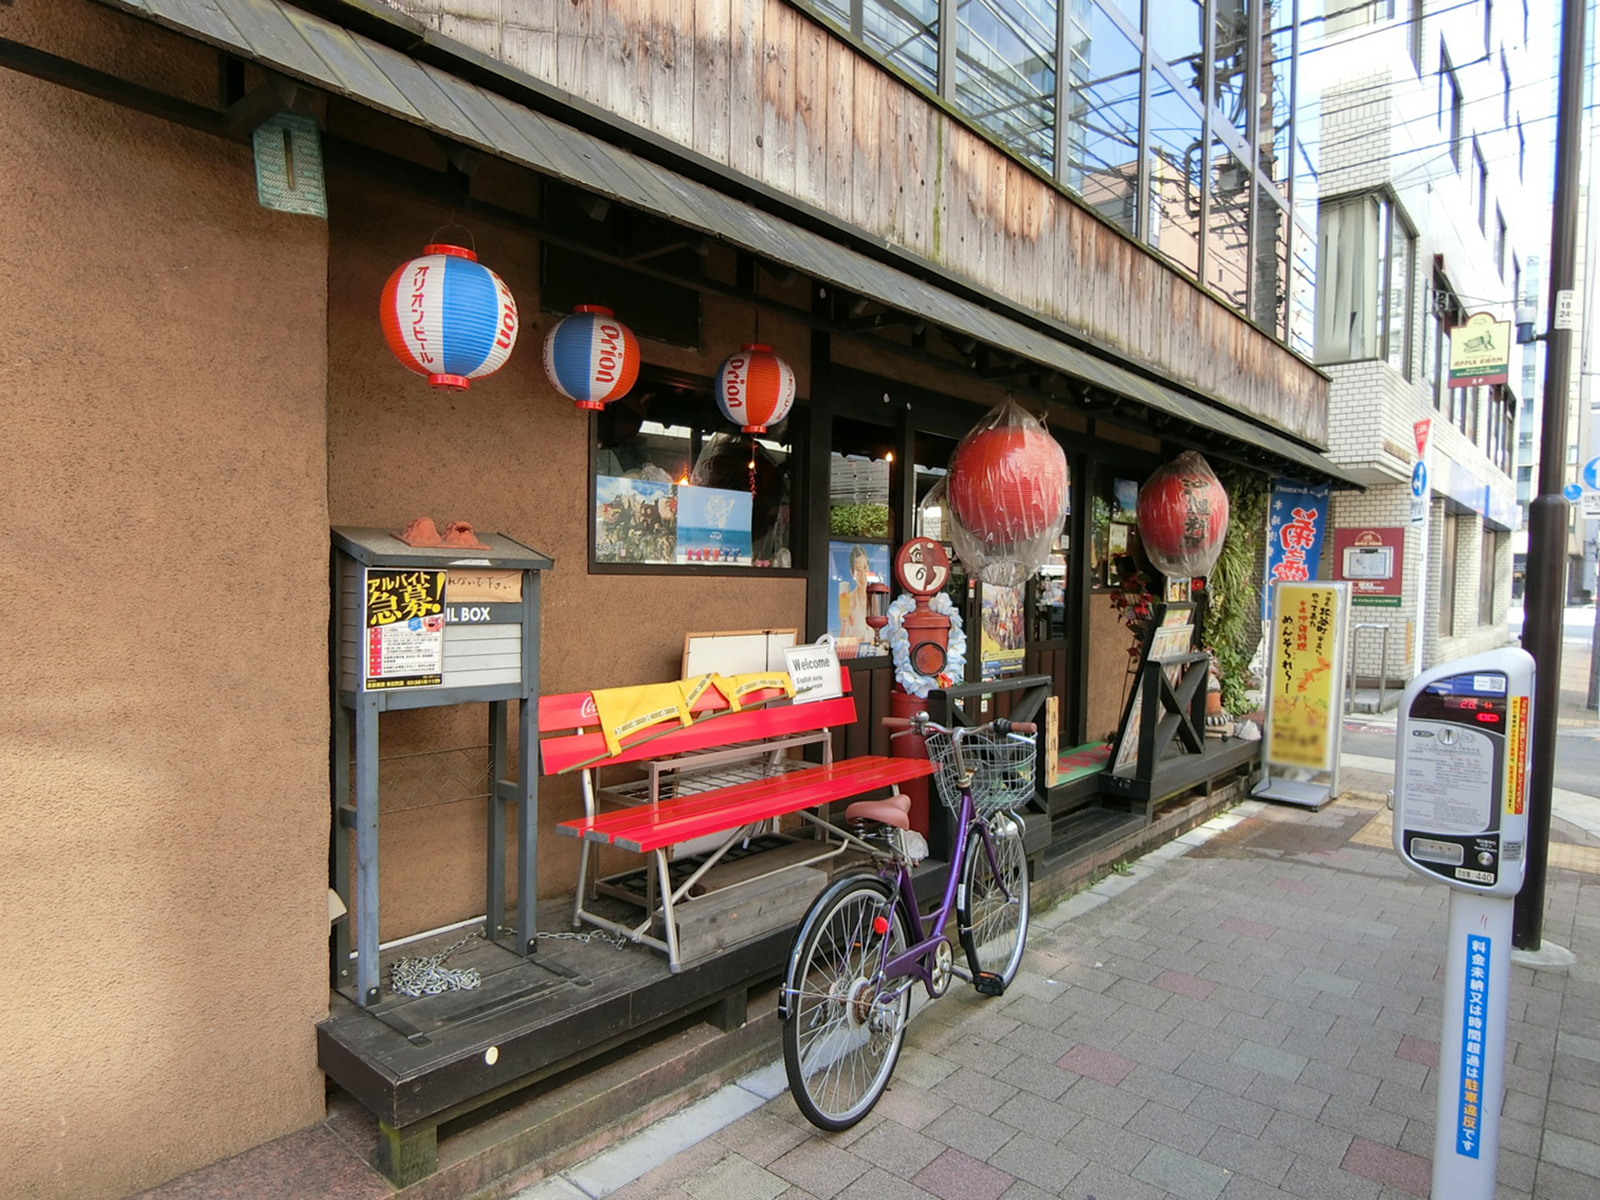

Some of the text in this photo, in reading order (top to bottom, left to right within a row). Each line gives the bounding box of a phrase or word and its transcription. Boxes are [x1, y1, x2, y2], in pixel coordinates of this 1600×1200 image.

[411, 266, 434, 364] オリオンビール
[595, 324, 623, 383] Orion
[726, 358, 745, 408] Orion
[367, 572, 431, 594] アルバイト
[367, 572, 446, 626] 急募!
[461, 606, 491, 621] BOX
[792, 657, 831, 671] Welcome
[1475, 872, 1493, 882] 440
